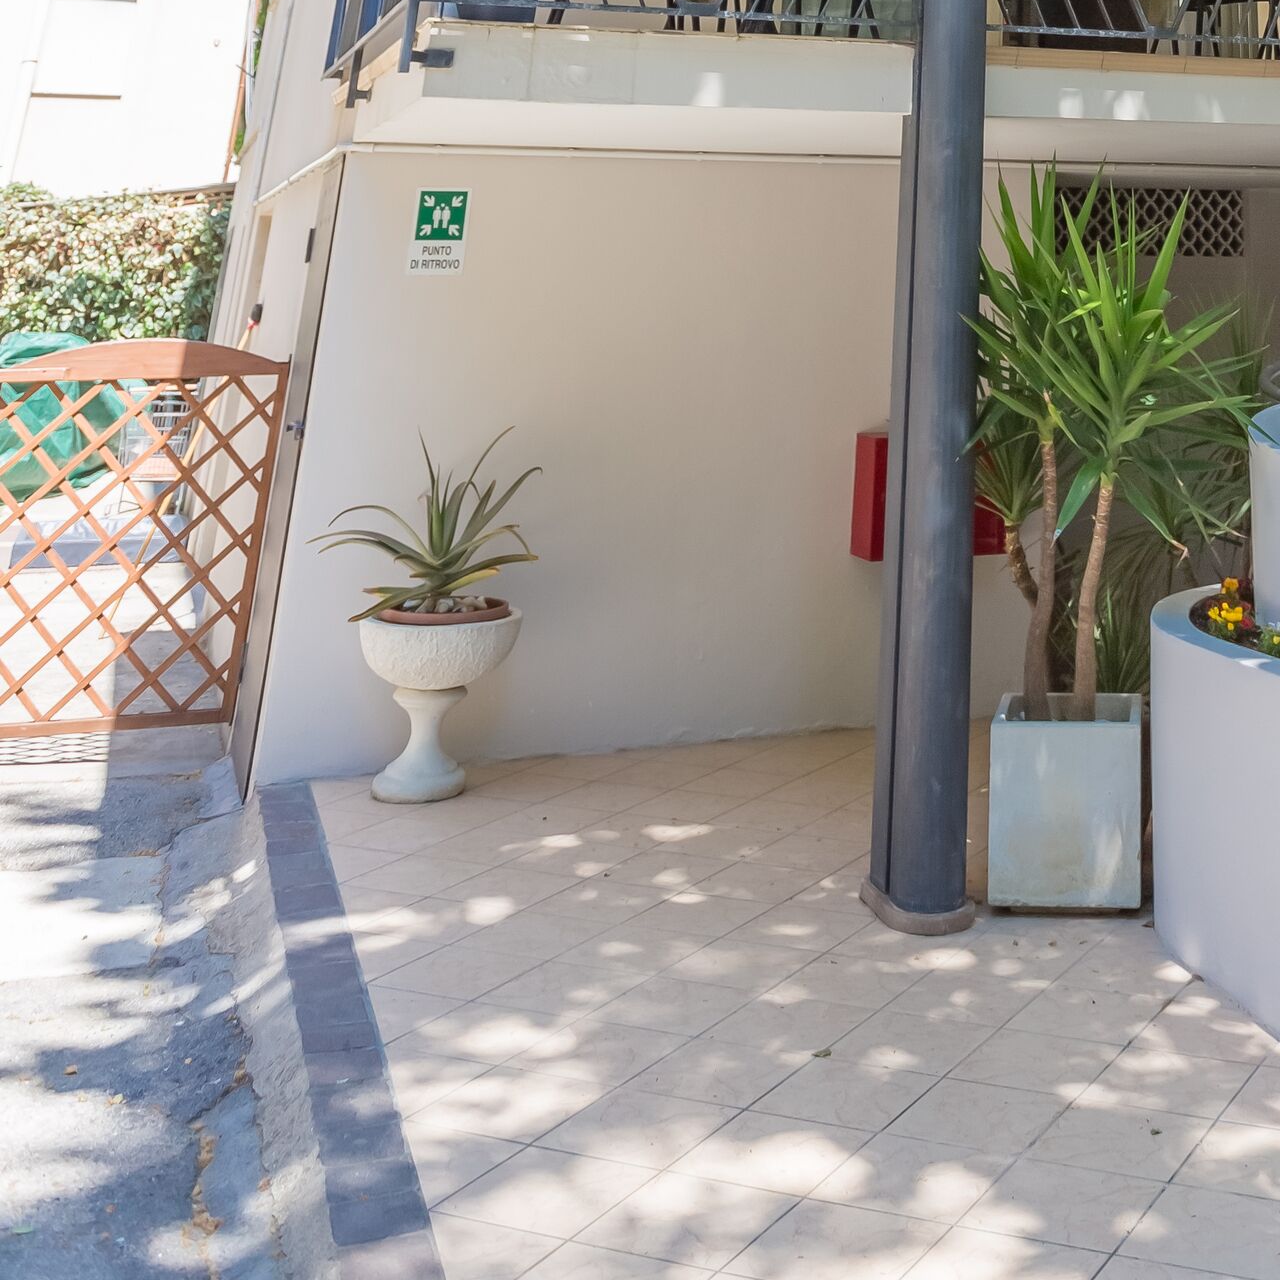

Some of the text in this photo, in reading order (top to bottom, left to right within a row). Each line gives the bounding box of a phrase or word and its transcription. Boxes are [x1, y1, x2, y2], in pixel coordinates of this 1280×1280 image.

[422, 245, 452, 256] PUNTO
[410, 259, 461, 270] DI RITROVO
